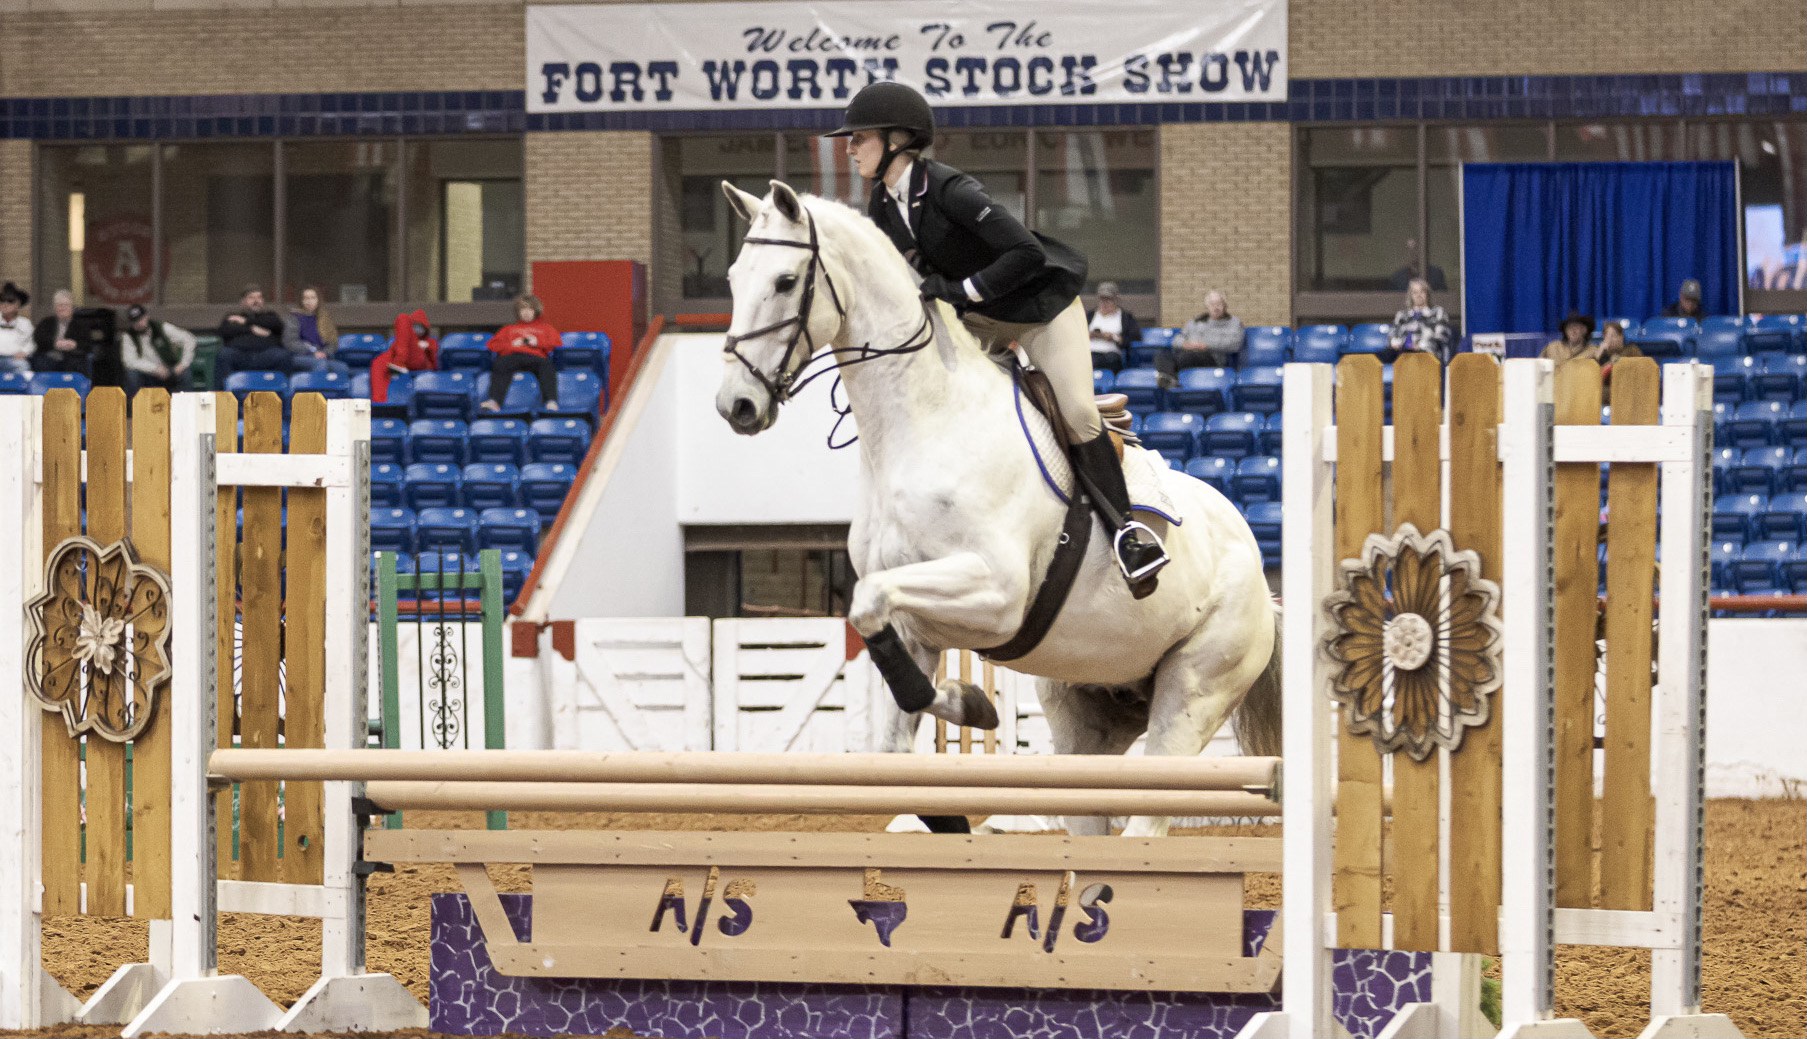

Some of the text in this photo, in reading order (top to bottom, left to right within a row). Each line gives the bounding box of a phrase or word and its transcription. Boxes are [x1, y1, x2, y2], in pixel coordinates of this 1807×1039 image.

[743, 20, 1053, 52] Welcome To The
[541, 50, 1279, 104] FORT WORTH STOCK SHOW
[649, 865, 757, 946] A/S
[1000, 870, 1114, 954] A/S
